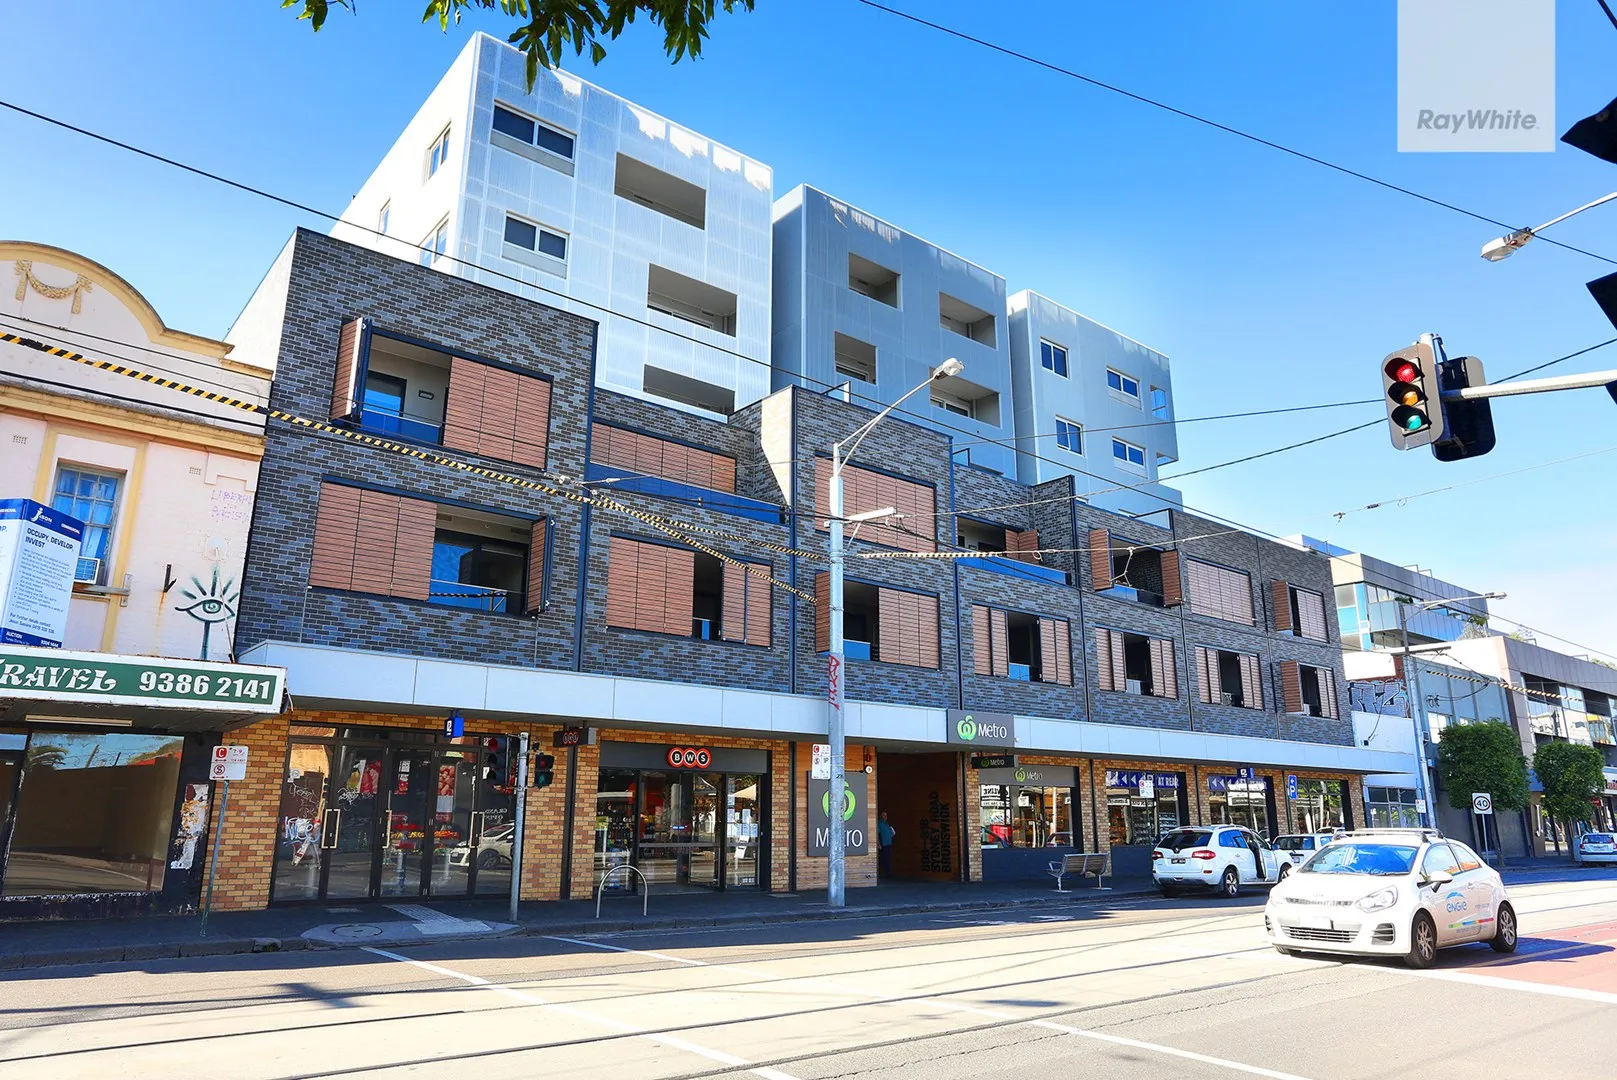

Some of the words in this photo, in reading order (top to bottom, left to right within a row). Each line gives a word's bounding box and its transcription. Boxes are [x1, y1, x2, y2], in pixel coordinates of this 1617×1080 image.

[25, 536, 46, 549] INVEST
[0, 659, 117, 692] RAVEL
[138, 670, 210, 696] 9386
[214, 676, 271, 700] 2141
[978, 723, 1007, 739] Metro
[1026, 771, 1043, 781] Metro
[1476, 800, 1488, 808] 40
[815, 827, 863, 847] Mro
